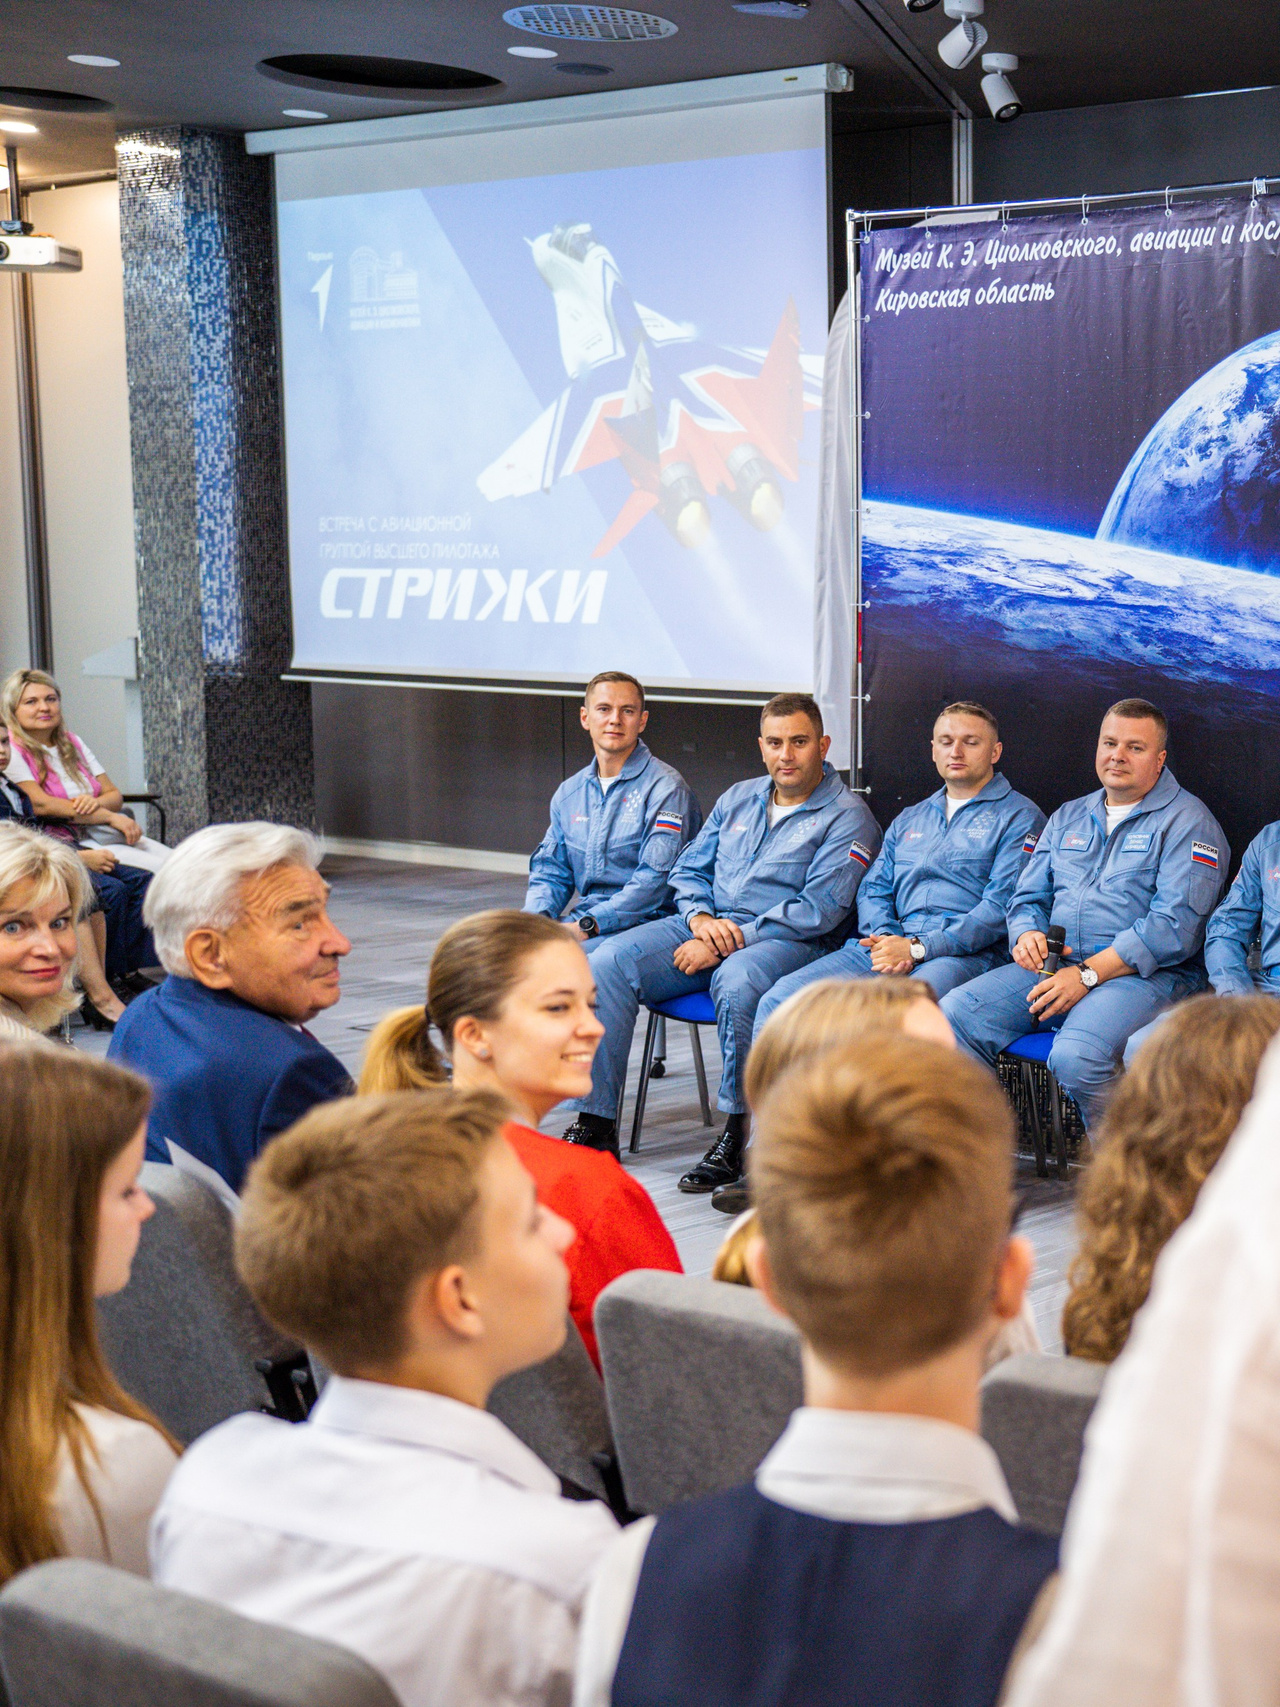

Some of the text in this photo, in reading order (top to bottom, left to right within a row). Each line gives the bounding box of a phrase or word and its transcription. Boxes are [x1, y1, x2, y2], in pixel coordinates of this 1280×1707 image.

[875, 244, 933, 278] Музей
[936, 243, 954, 269] К.
[960, 241, 977, 267] Э.
[984, 234, 1122, 270] Циолковского,
[1130, 226, 1217, 253] авиации
[1220, 225, 1236, 244] и
[875, 277, 1055, 315] Кировская область
[319, 512, 472, 533] ВСТРЕЧА С АВИАЦИОННОЙ
[320, 541, 500, 559] ГРУППОЙ ВЫСШЕГО ПИЛОТАЖА
[320, 568, 609, 624] СТРИЖИ
[1193, 842, 1218, 854] РОССИЯ
